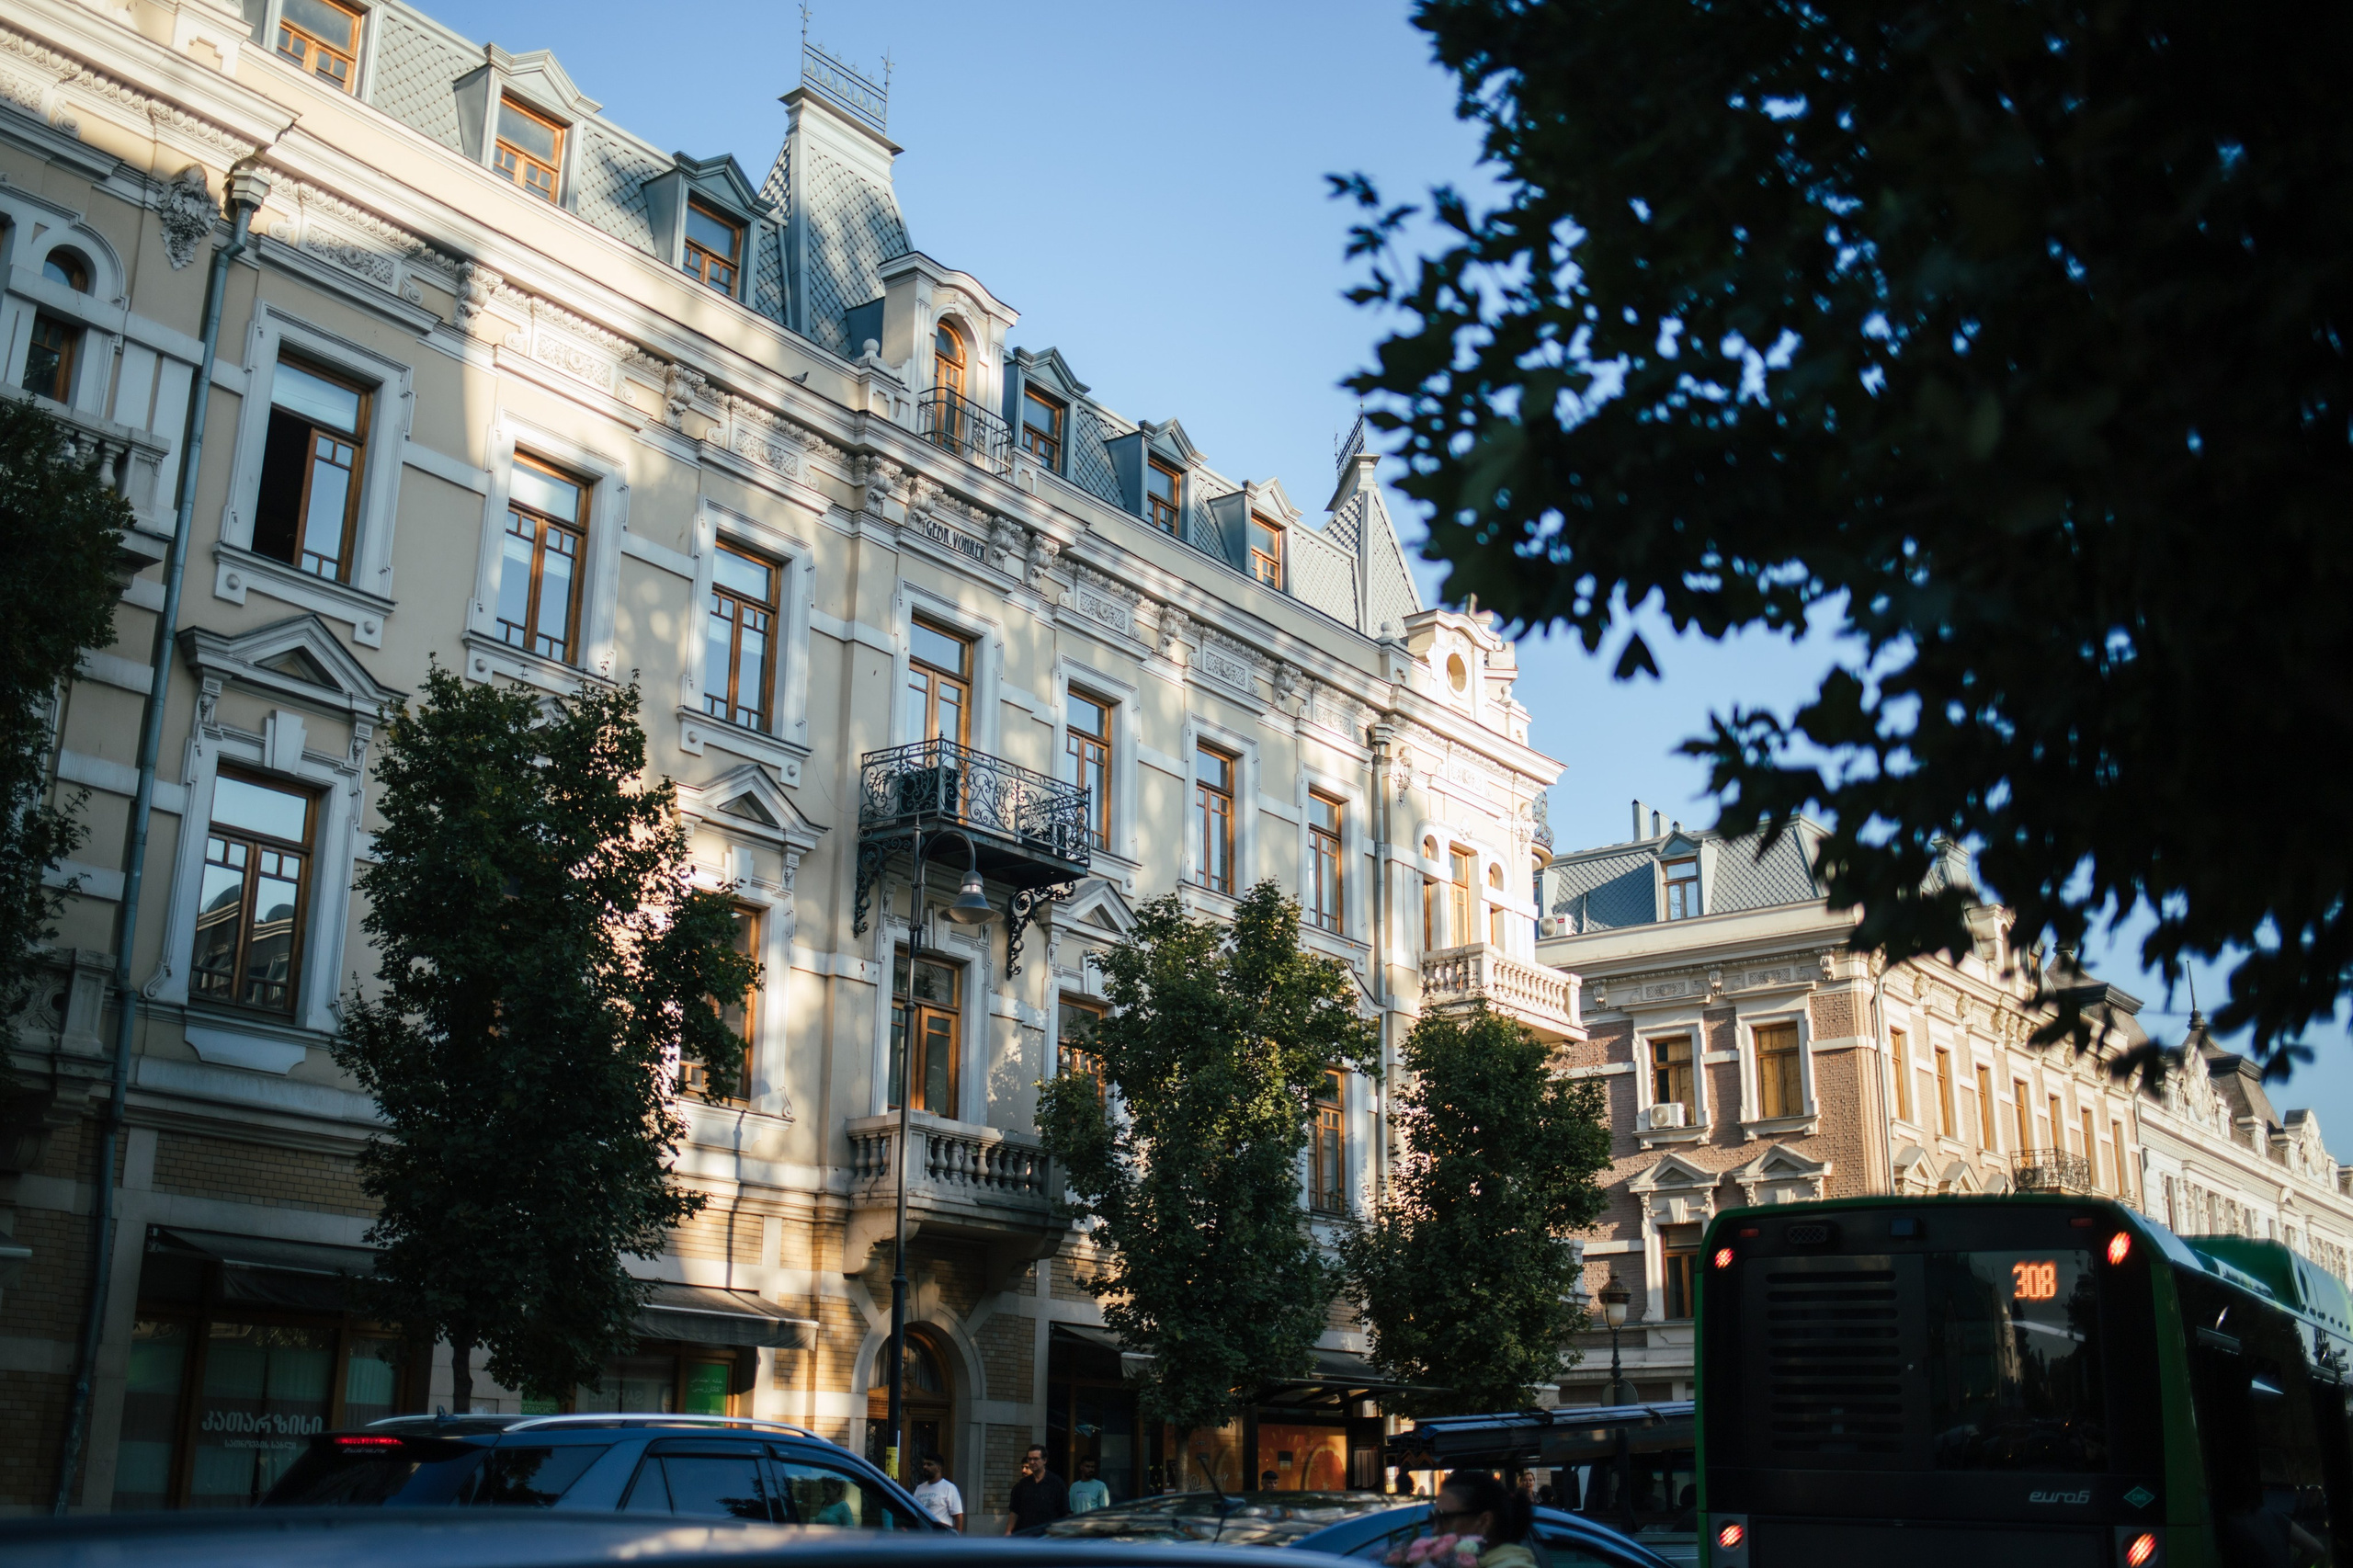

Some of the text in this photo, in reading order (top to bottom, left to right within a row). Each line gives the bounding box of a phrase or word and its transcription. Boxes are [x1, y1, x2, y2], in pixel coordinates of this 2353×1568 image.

[926, 520, 986, 562] GEBR. VOHRER
[2012, 1262, 2056, 1299] 308
[201, 1410, 324, 1436] კათარზისი
[2029, 1490, 2091, 1505] euro6
